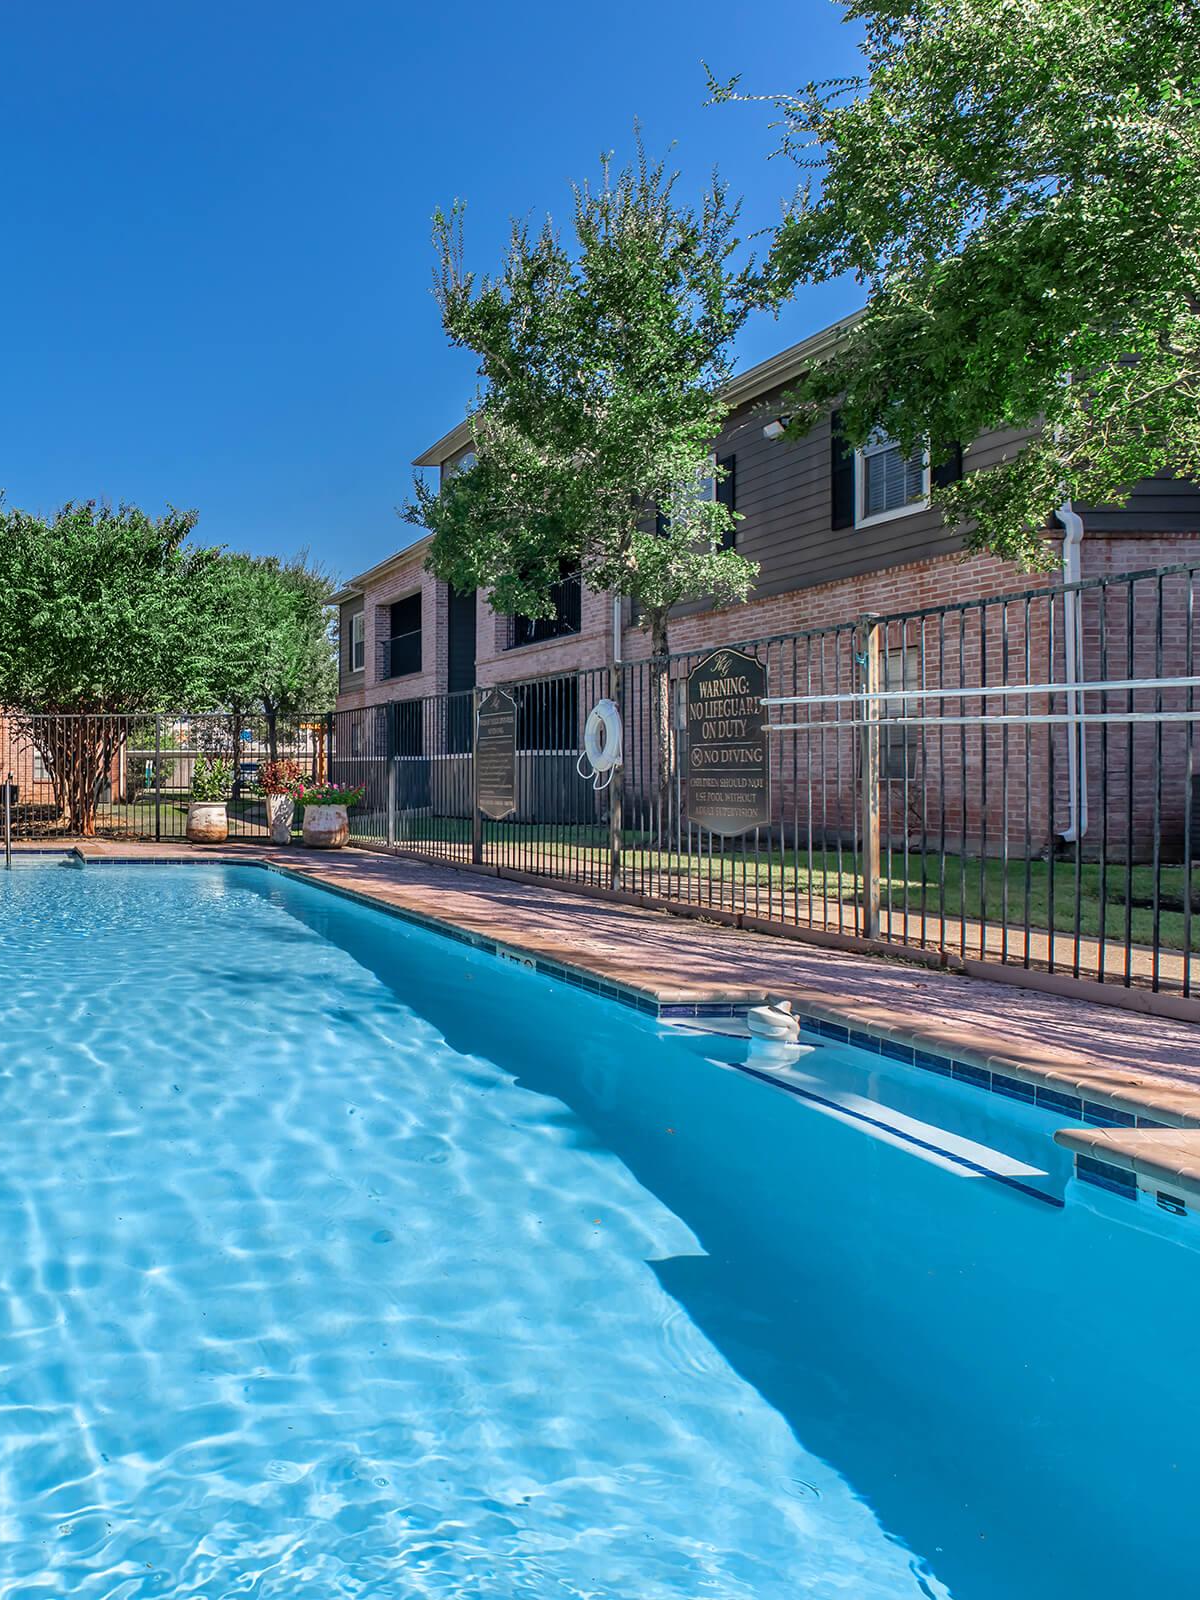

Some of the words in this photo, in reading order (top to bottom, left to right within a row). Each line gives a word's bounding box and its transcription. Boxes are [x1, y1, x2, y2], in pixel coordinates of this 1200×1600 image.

[699, 677, 749, 698] WARNING:
[689, 702, 704, 720] NO
[705, 696, 763, 719] LIFEGUARD
[702, 720, 717, 739] ON
[718, 719, 747, 738] DUTY
[704, 750, 719, 763] NO
[721, 748, 763, 763] DIVING
[720, 777, 748, 788] SHOULD
